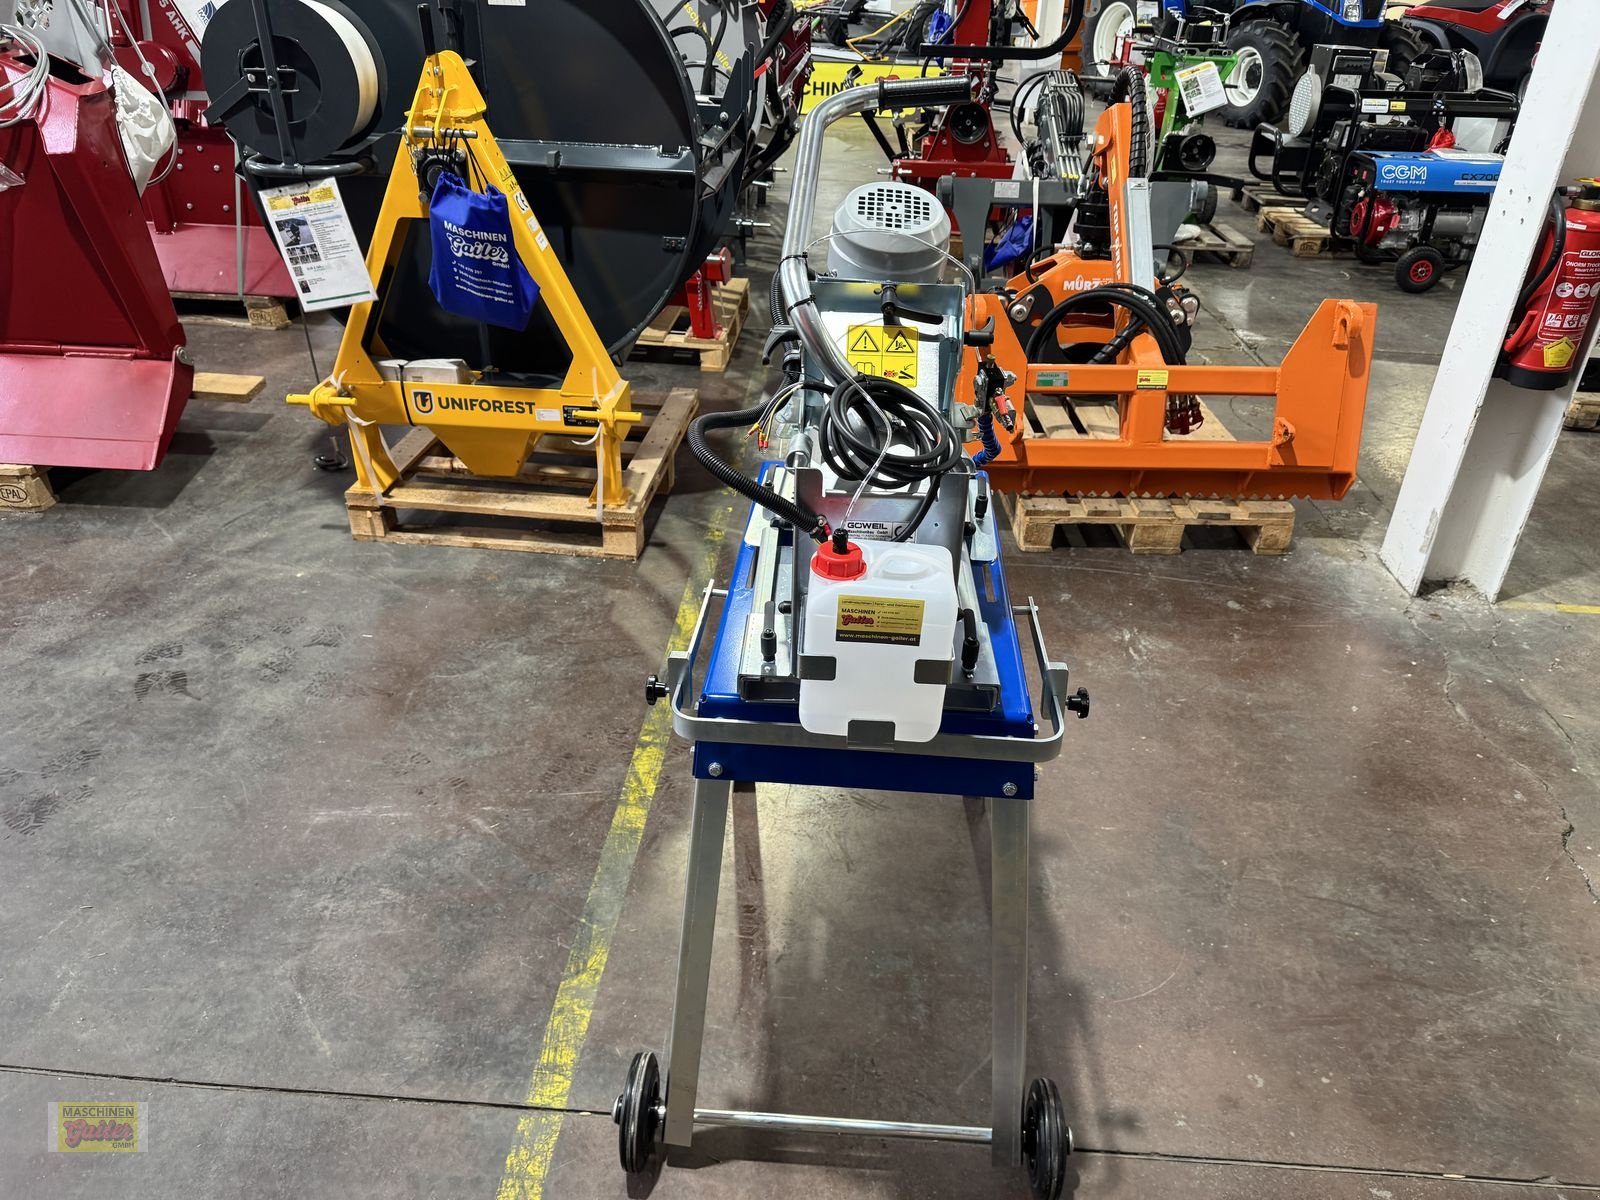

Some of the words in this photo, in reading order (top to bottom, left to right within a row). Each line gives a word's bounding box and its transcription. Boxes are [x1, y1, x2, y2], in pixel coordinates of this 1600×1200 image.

[166, 10, 190, 41] AHK
[1381, 164, 1427, 180] CGM
[443, 219, 508, 243] MASCHINEN
[446, 232, 509, 263] Gailer
[437, 396, 536, 415] UNIFOREST
[841, 608, 876, 616] MASCHINEN
[839, 633, 917, 643] www.maschinen-gailer.at
